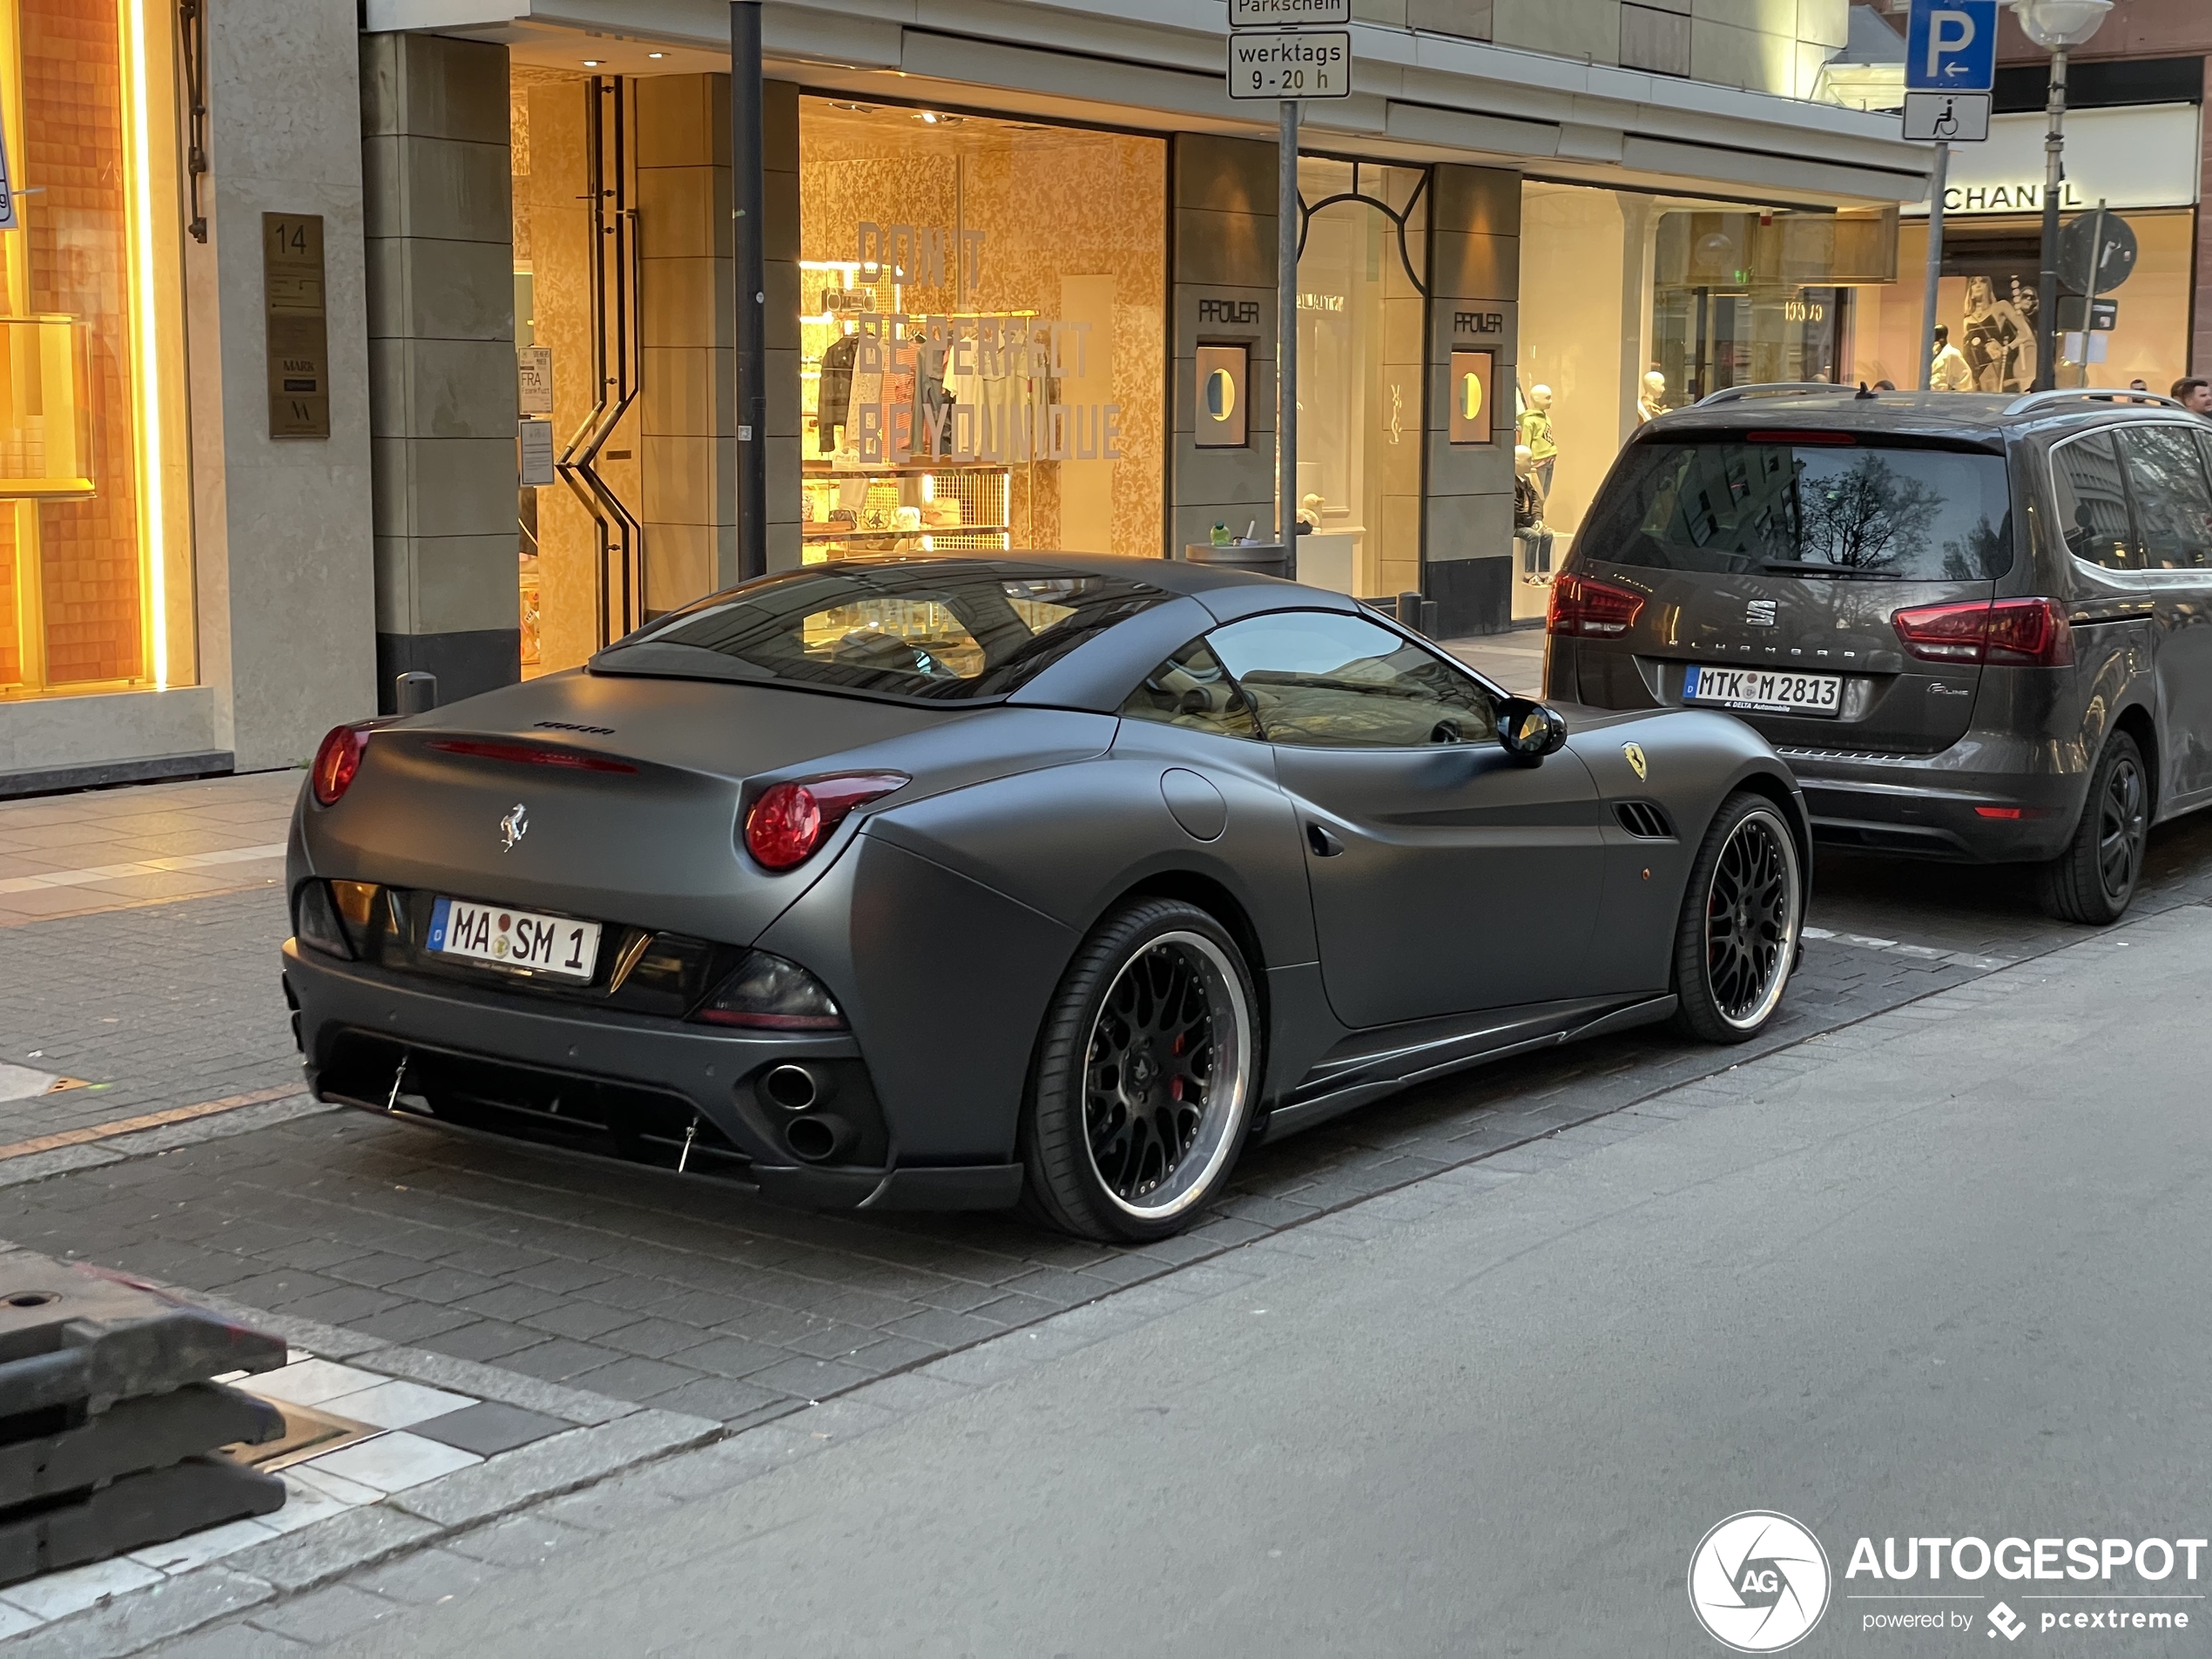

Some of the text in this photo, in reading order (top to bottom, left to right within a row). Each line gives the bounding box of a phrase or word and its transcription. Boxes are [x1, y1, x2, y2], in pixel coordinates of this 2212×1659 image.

[1238, 43, 1342, 66] werktags
[1925, 10, 1975, 78] P
[1317, 69, 1329, 89] h
[1943, 184, 2082, 210] CHANL
[275, 224, 307, 254] 14
[858, 221, 986, 289] DON'T
[858, 313, 1092, 378] BE PERFECT
[521, 372, 542, 387] FRA
[859, 403, 1121, 466] BE YOUNIQUE
[1698, 671, 1743, 698] MTK
[1758, 675, 1776, 700] M
[1777, 677, 1837, 705] 2813
[452, 907, 490, 953] MA
[512, 918, 556, 963] SM
[564, 927, 584, 969] 1
